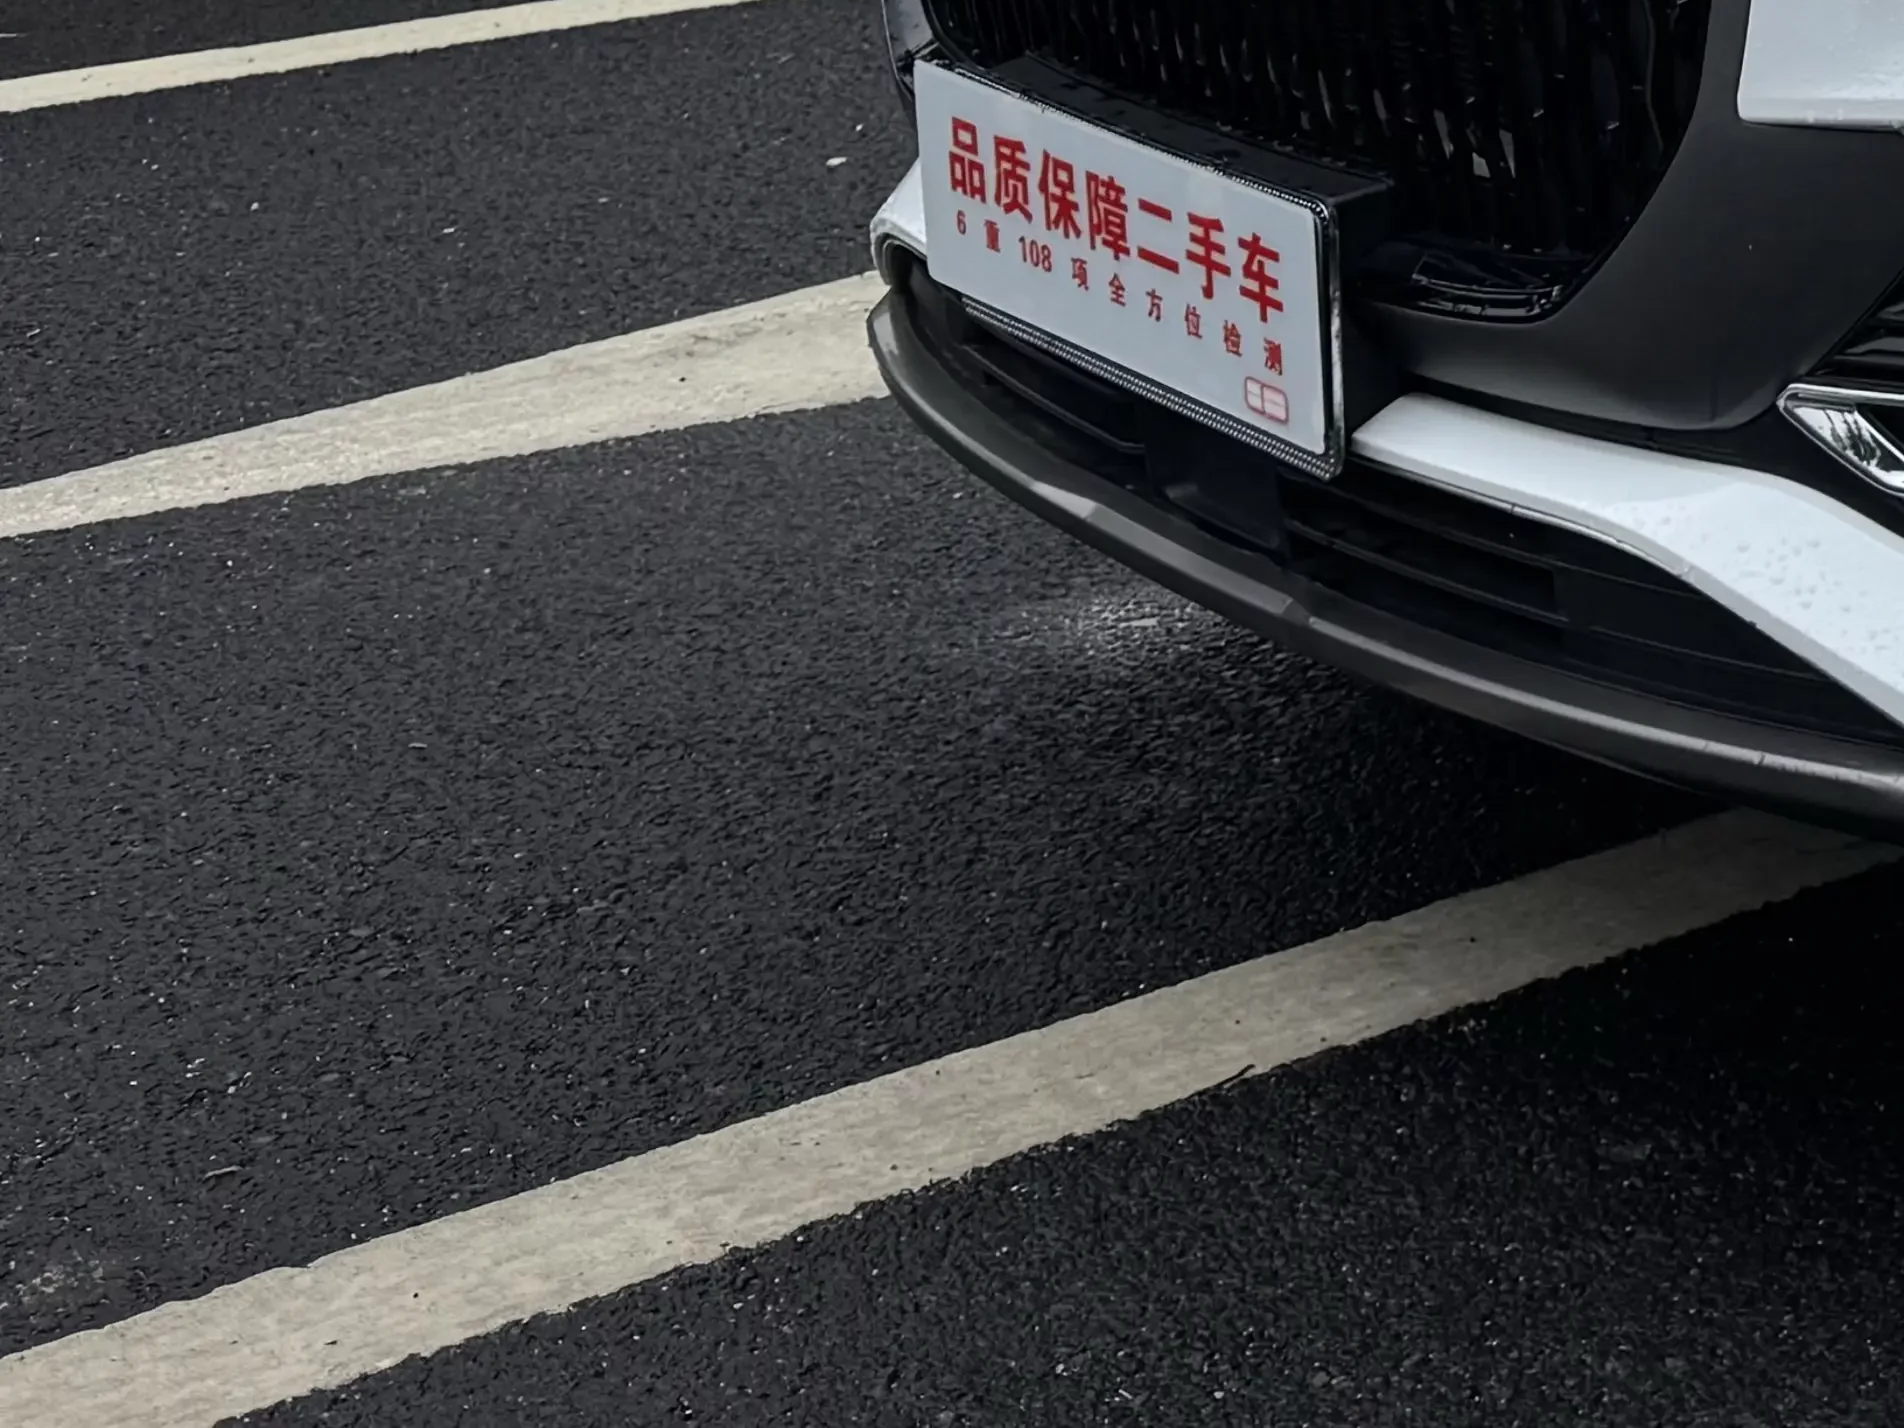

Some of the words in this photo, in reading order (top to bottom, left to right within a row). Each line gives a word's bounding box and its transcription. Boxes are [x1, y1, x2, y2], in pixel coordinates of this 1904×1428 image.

[948, 115, 1285, 324] 品质保障二手车
